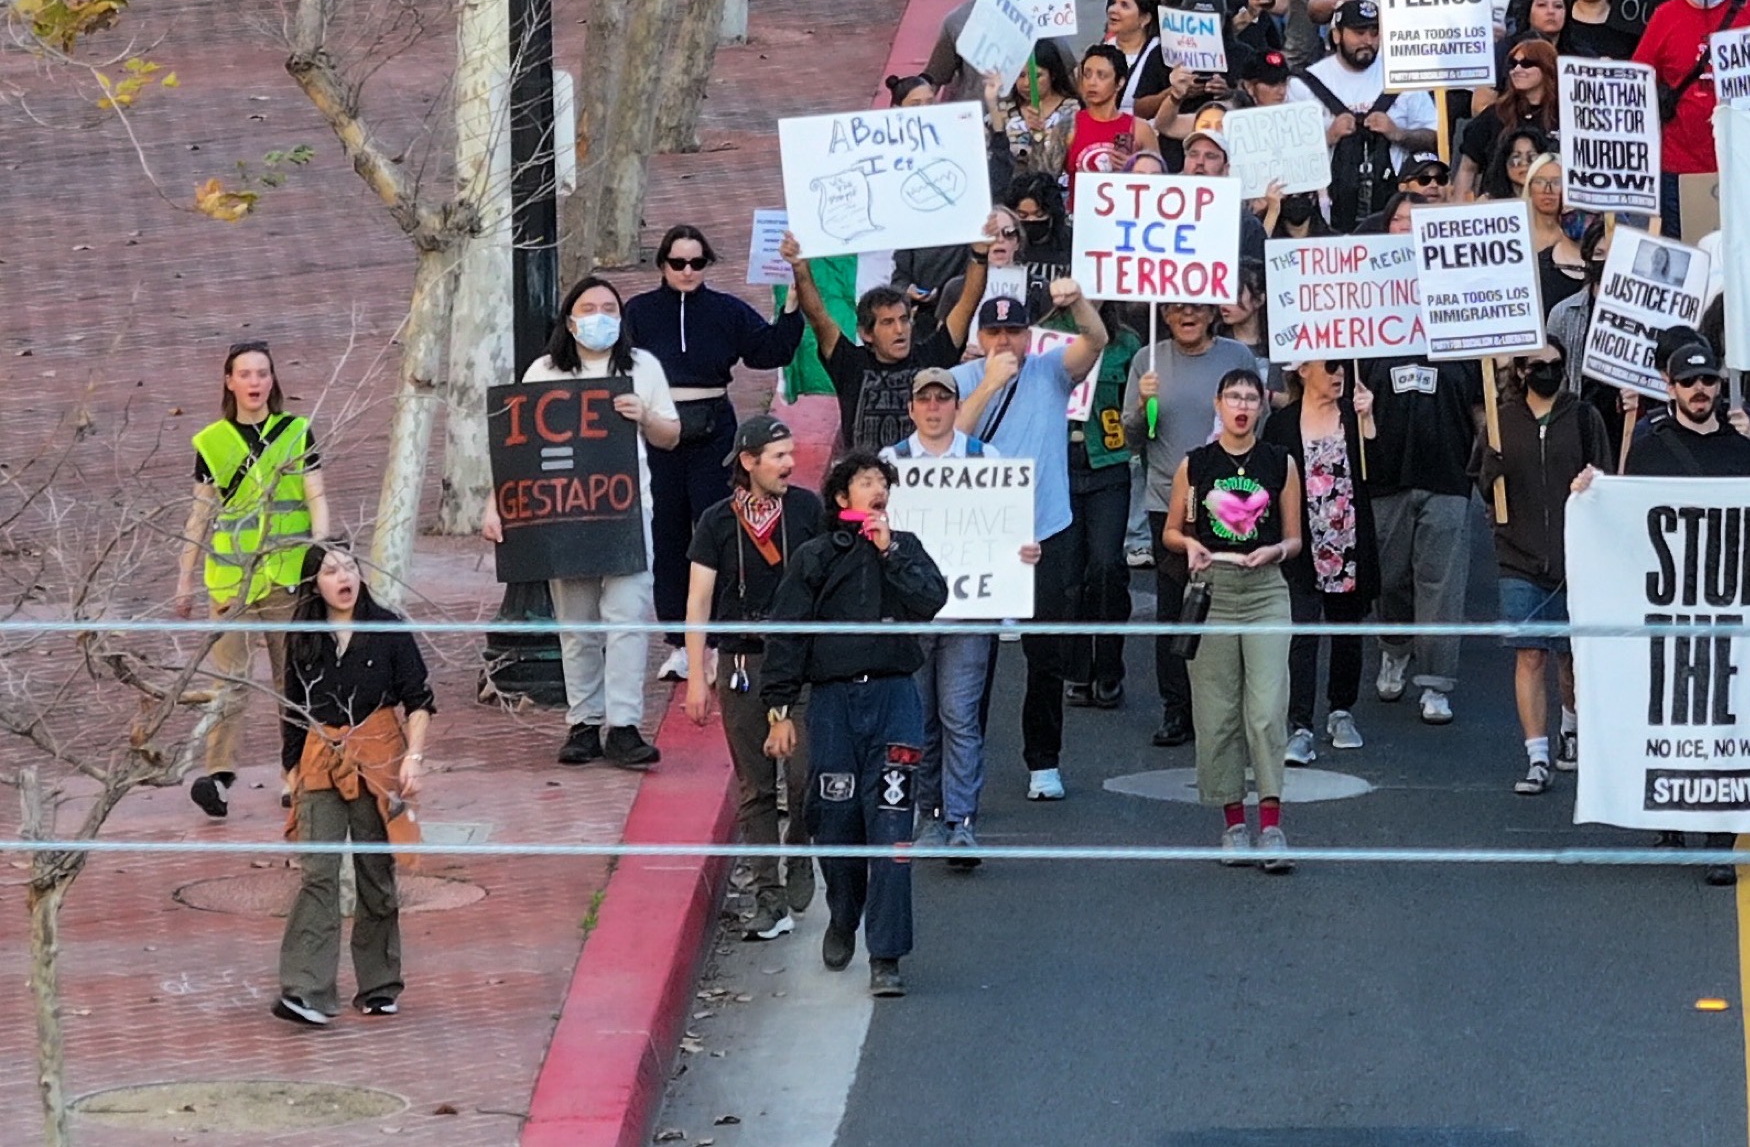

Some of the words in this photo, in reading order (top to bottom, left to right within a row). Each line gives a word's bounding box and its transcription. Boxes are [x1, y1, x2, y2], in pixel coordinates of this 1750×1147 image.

[1162, 14, 1215, 36] ALIGN
[1389, 29, 1421, 41] PARA
[1424, 27, 1462, 40] TODOS
[1464, 26, 1487, 38] LOS
[1390, 41, 1487, 57] INMIGRANTES!
[1563, 63, 1650, 80] ARREST
[1570, 79, 1646, 108] JONATHAN
[1574, 106, 1612, 131] ROSS
[1614, 109, 1645, 133] FOR
[1573, 137, 1648, 172] MURDER
[1568, 170, 1655, 192] NOW!
[1094, 183, 1215, 222] STOP
[1115, 222, 1196, 253] ICE
[1420, 216, 1521, 242] ¡DERECHOS
[1298, 245, 1368, 277] TRUMP
[1423, 239, 1524, 271] PLENOS
[1085, 250, 1230, 298] TERROR
[1427, 292, 1460, 307] PARA
[1463, 290, 1503, 305] TODOS
[1506, 288, 1530, 302] LOS
[1428, 303, 1532, 324] INMIGRANTES!
[1294, 316, 1427, 351] AMERICA
[503, 390, 610, 446] ICE
[500, 474, 634, 521] GESTAPO
[1644, 614, 1743, 726] THE
[1646, 738, 1671, 758] NO
[1675, 738, 1709, 759] ICE,
[1713, 739, 1736, 757] NO
